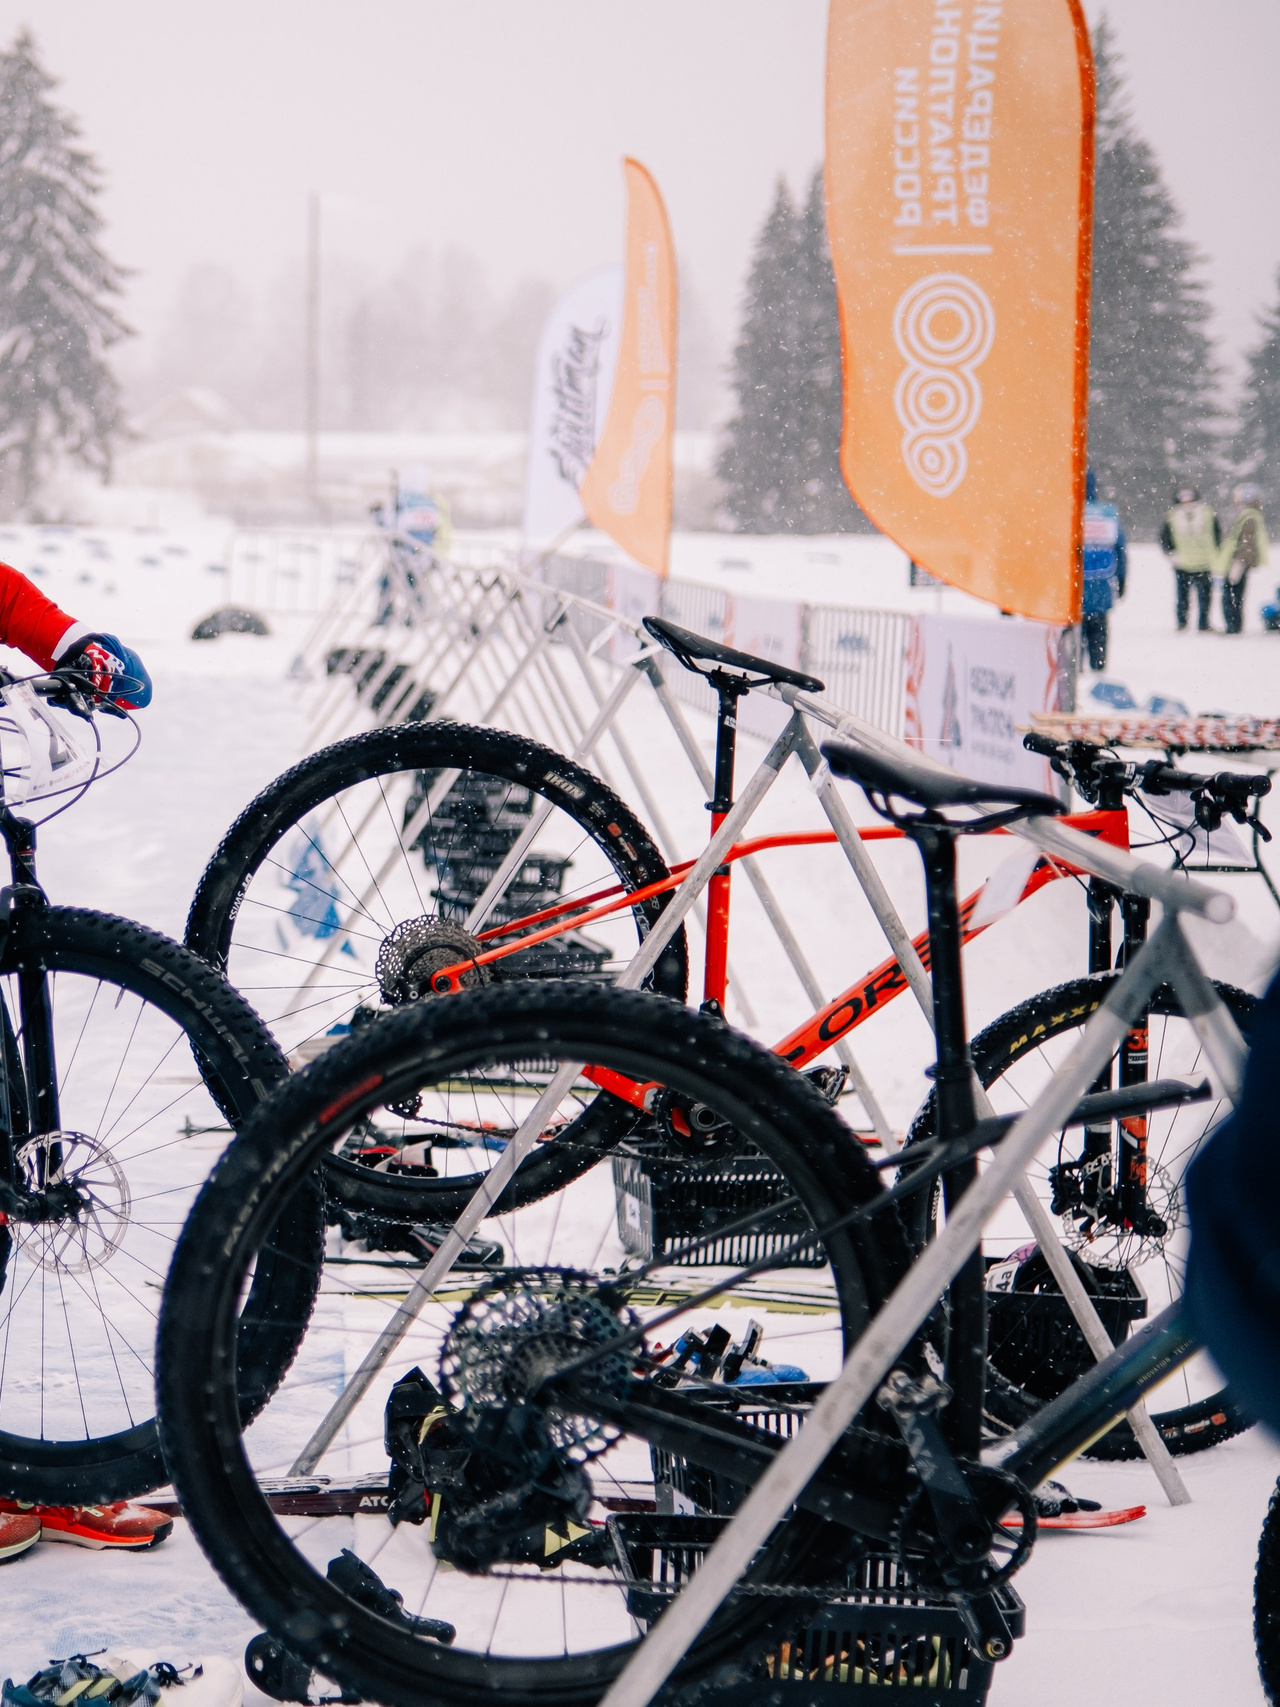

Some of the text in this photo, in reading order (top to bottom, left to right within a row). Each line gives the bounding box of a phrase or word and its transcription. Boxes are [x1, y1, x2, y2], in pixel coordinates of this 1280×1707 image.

[543, 771, 586, 800] IKON
[229, 891, 246, 921] SWISS
[140, 958, 269, 1102] SCHWALB
[1009, 1001, 1099, 1054] MAXXI
[1136, 1356, 1172, 1386] INNOVATION
[358, 1495, 389, 1508] ATO
